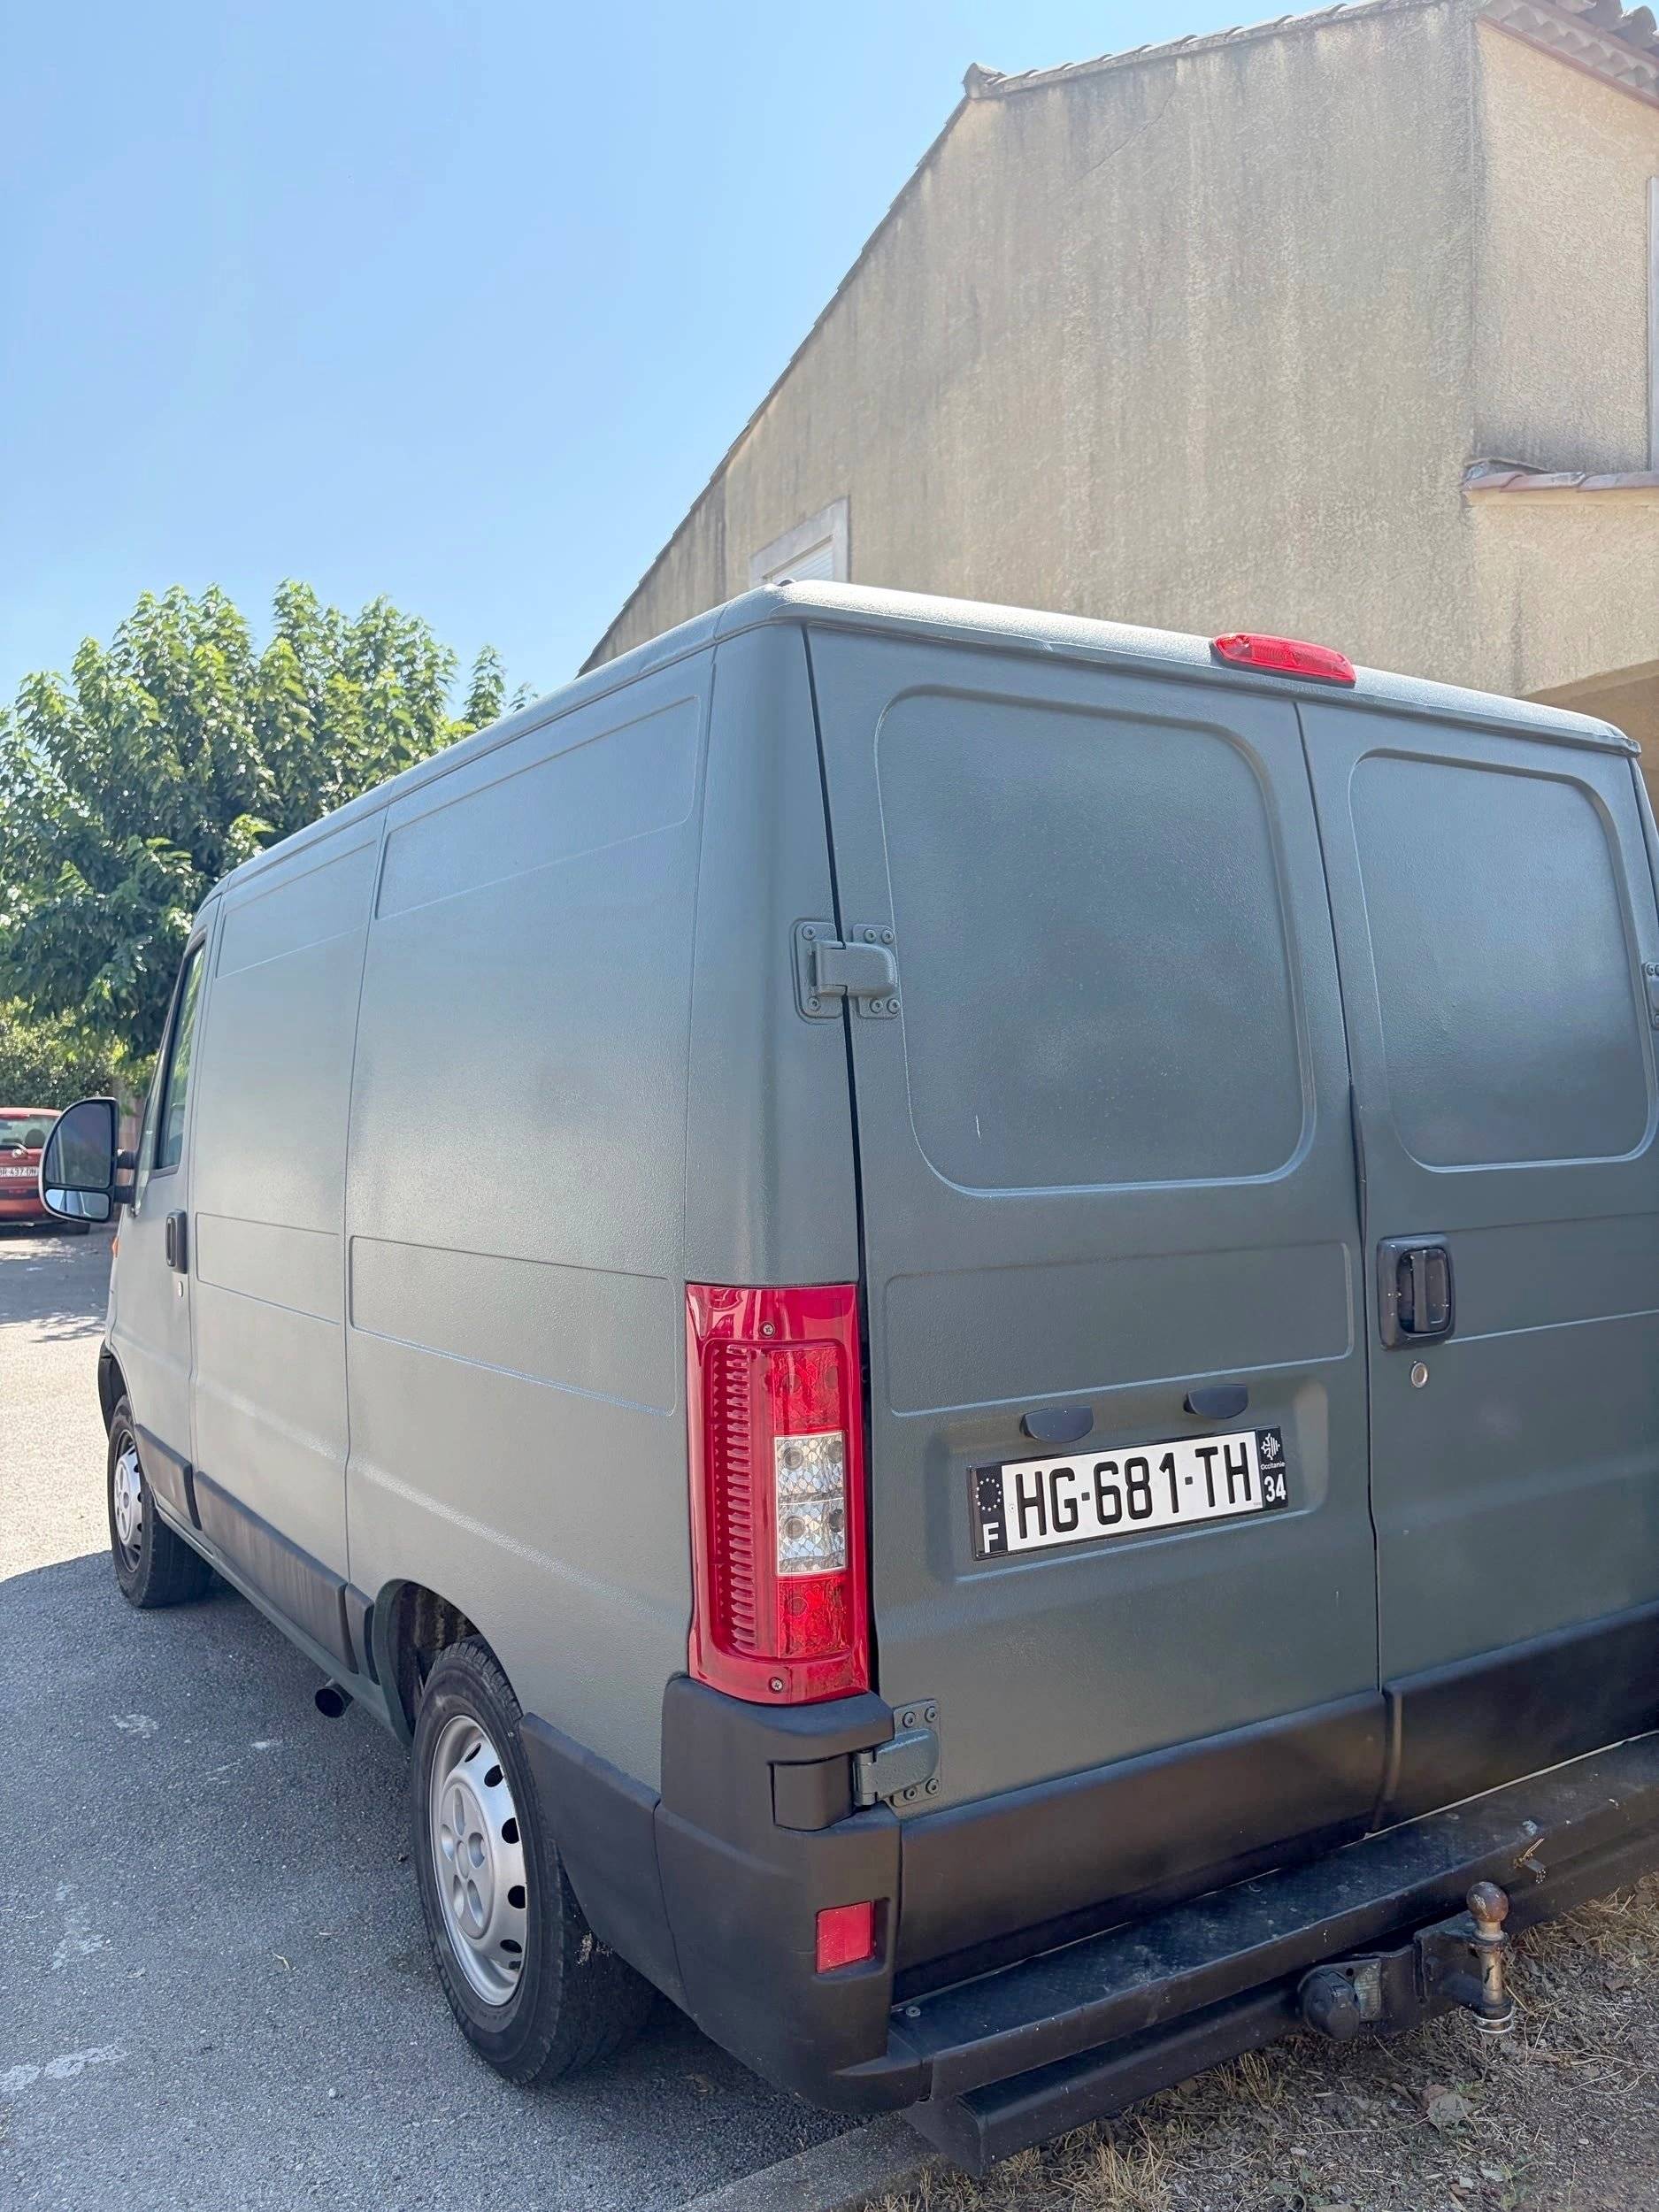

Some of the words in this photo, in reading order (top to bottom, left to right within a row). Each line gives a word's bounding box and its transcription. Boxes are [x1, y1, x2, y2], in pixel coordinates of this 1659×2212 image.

[1260, 1461, 1286, 1470] Occitanie
[1015, 1442, 1252, 1539] HG-681-TH
[1263, 1473, 1286, 1502] 34
[982, 1522, 999, 1553] F
